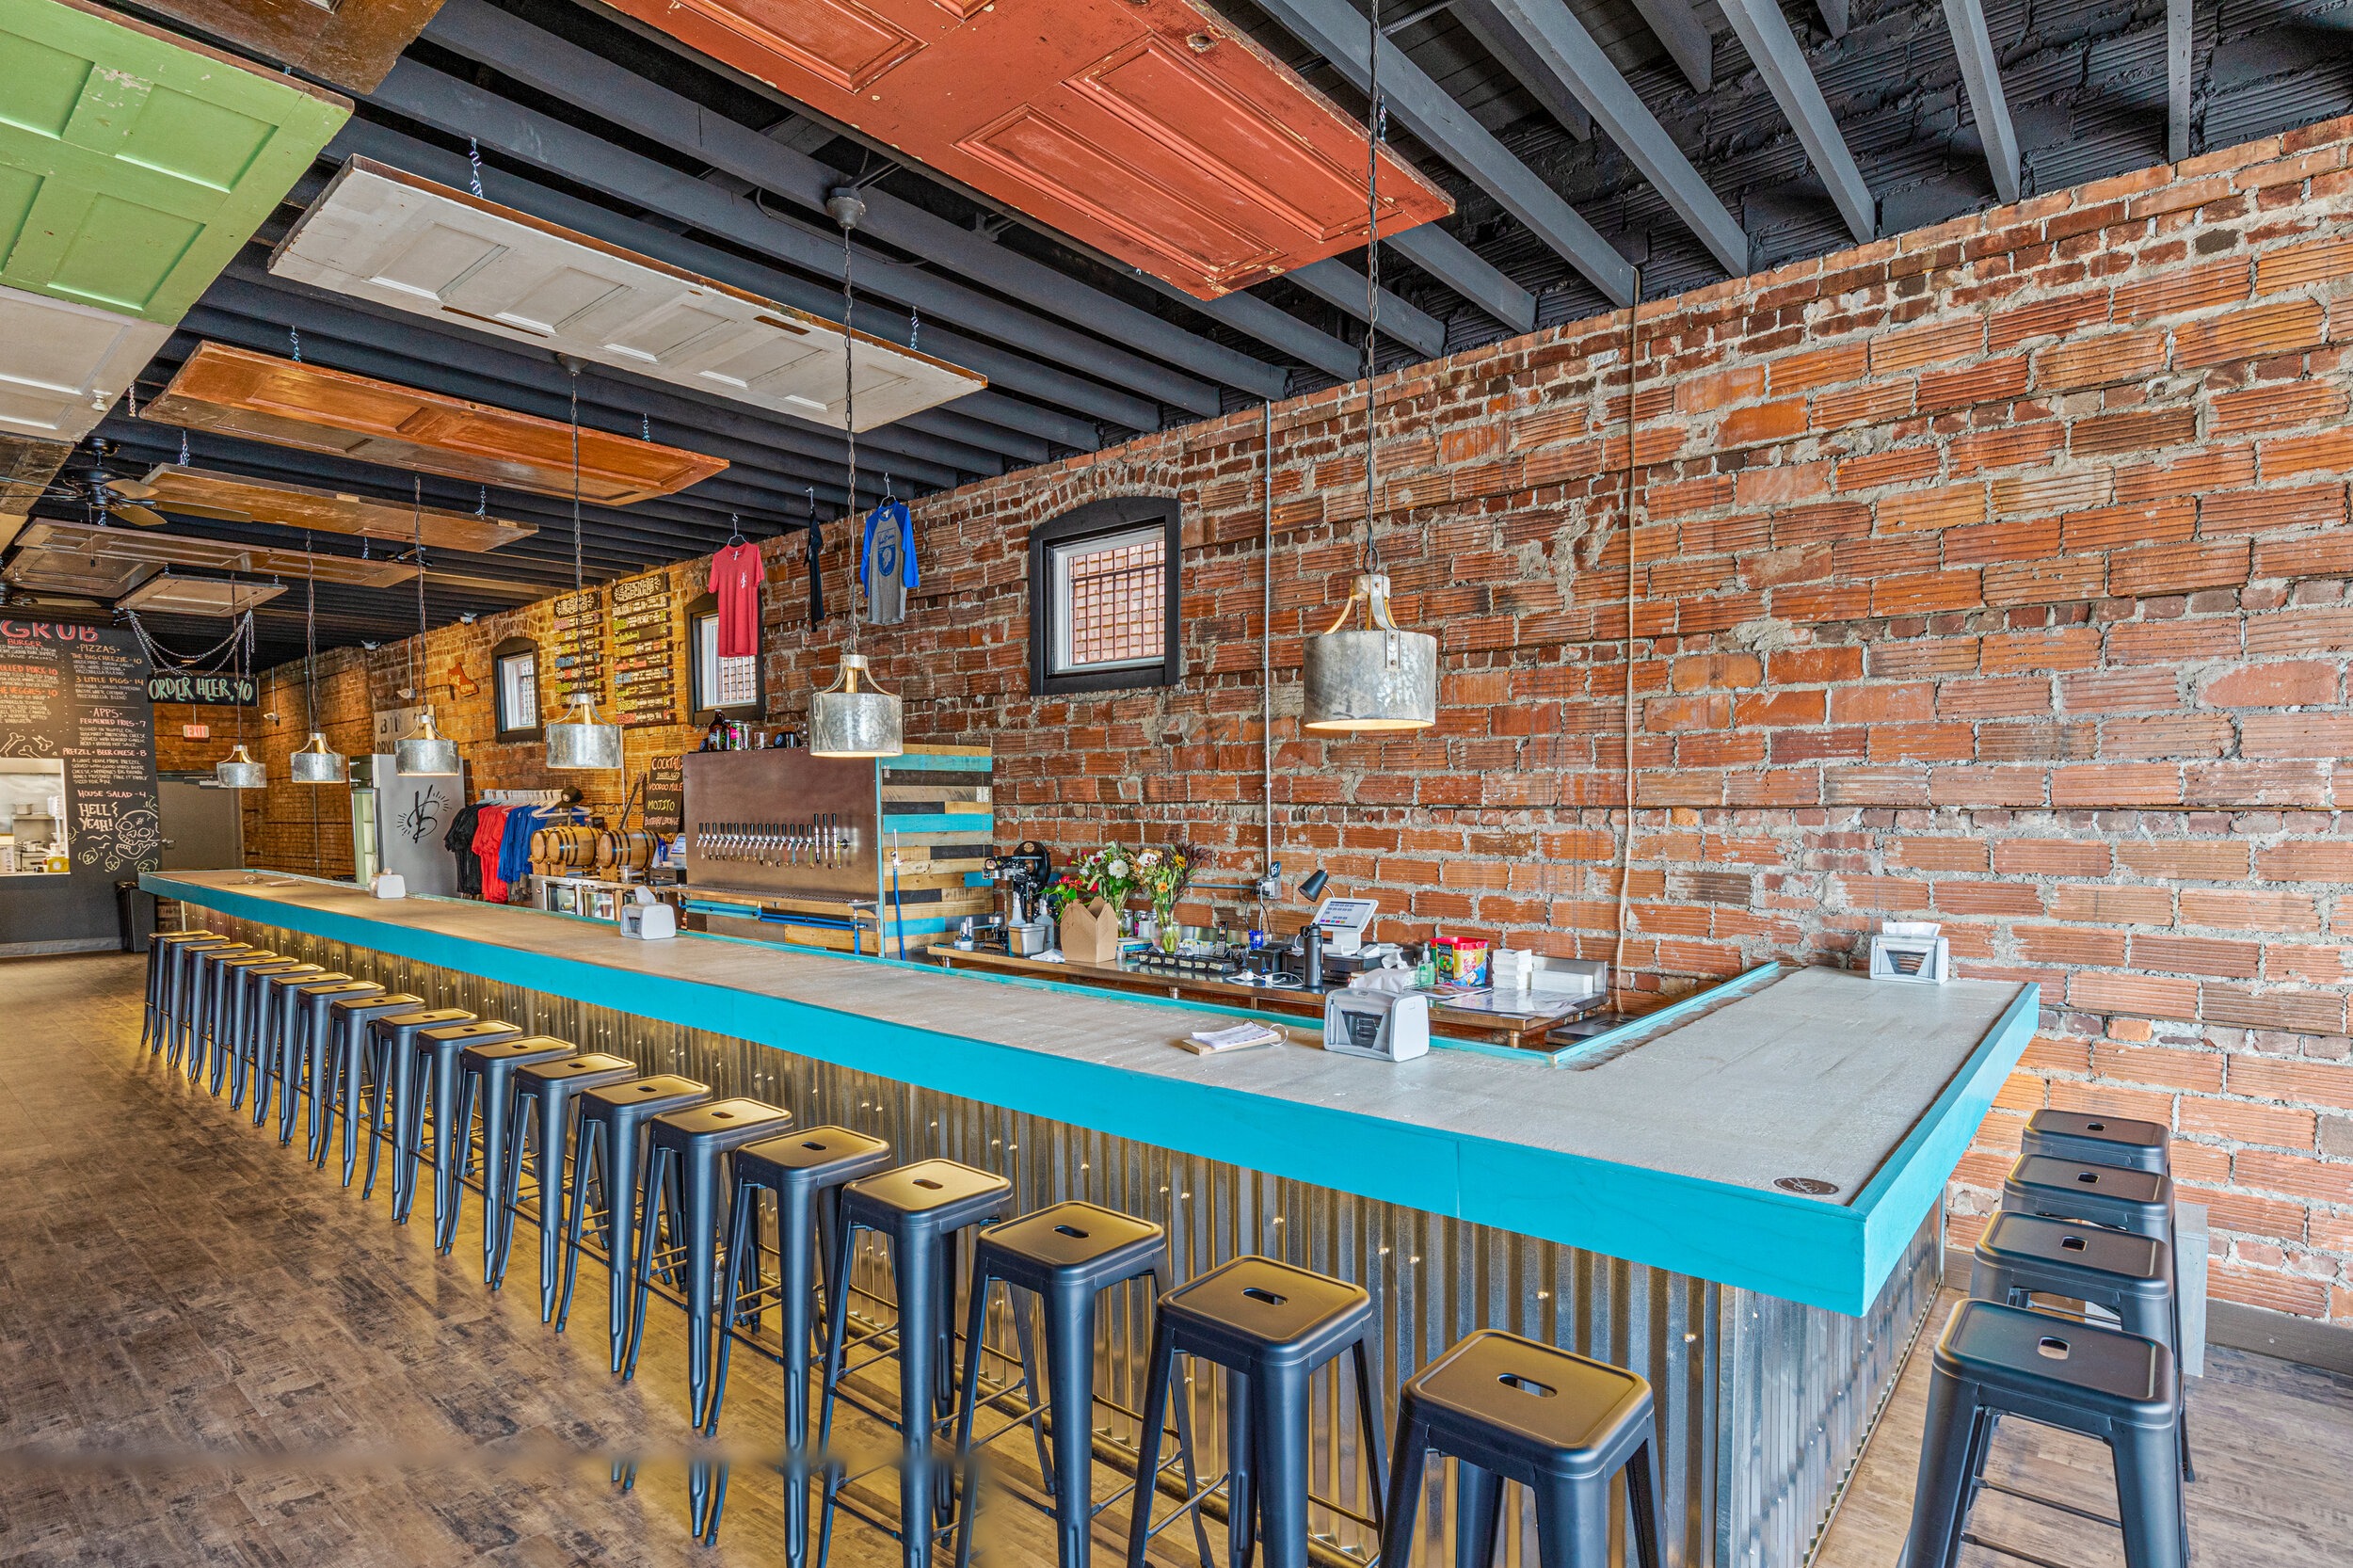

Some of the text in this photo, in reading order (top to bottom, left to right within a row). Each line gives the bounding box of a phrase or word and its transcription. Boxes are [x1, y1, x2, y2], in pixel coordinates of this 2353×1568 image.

[0, 619, 99, 643] GRUB
[7, 638, 44, 648] BURGER
[80, 644, 117, 654] PIZZAS
[48, 667, 58, 676] 10
[135, 678, 144, 686] 14
[48, 689, 58, 697] 10
[148, 676, 196, 702] ORDER
[93, 708, 120, 719] APPS
[79, 717, 116, 726] FERMENTED
[139, 720, 147, 728] 7
[187, 725, 206, 738] EXIT
[62, 747, 91, 756] PRETZEL
[96, 748, 113, 757] BEER
[140, 749, 148, 758] 8
[648, 782, 683, 792] VOODOO MULE
[77, 789, 104, 799] HOUSE
[105, 790, 134, 799] SALAD
[647, 799, 676, 811] MOJITO
[78, 803, 111, 819] HELL
[78, 816, 114, 833] YEAH!
